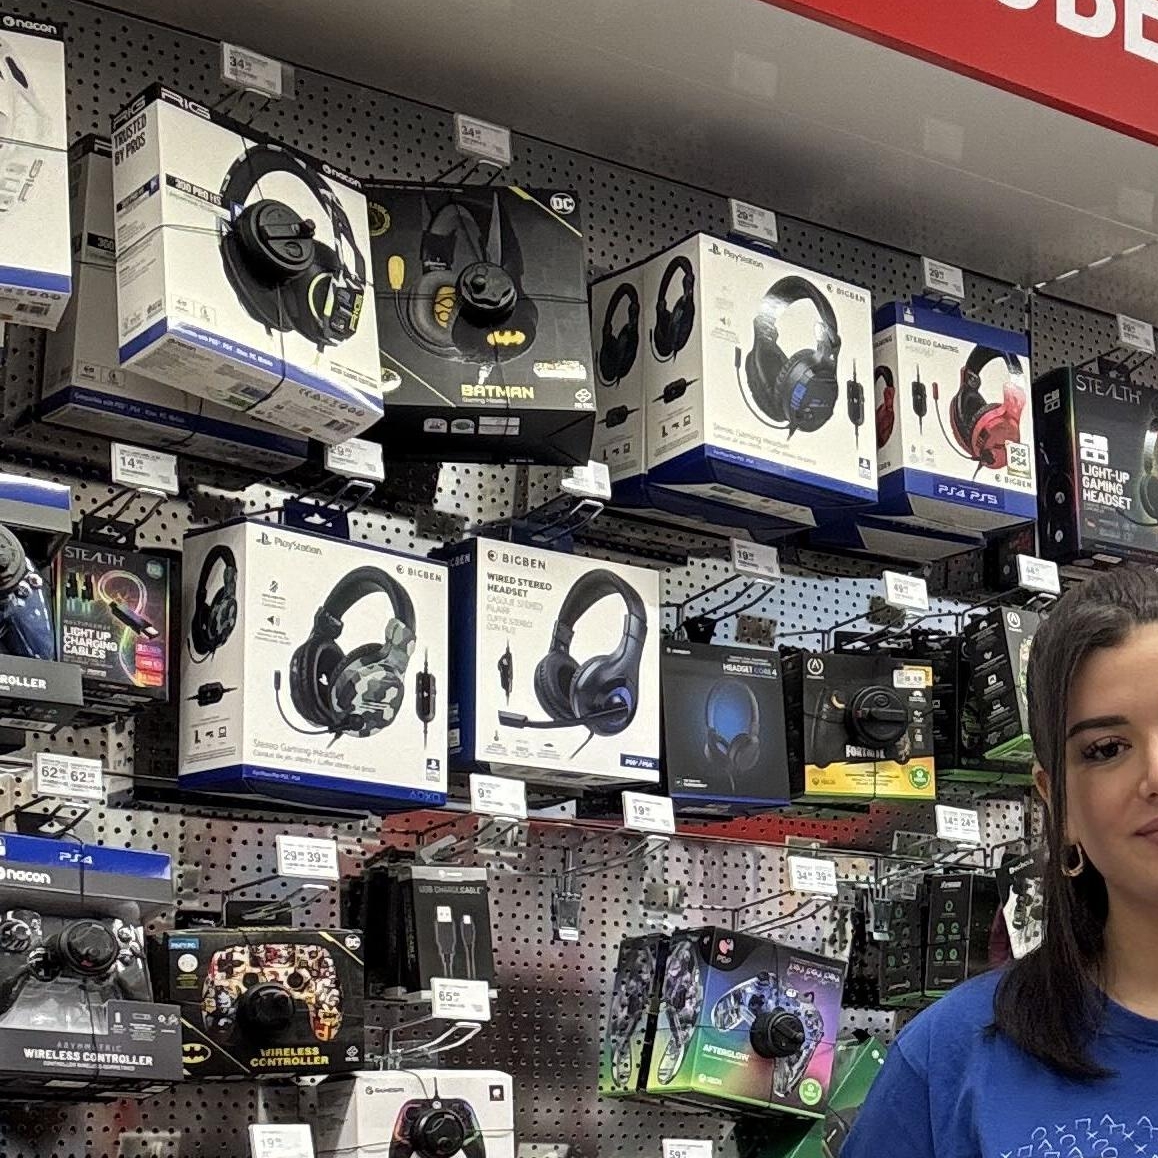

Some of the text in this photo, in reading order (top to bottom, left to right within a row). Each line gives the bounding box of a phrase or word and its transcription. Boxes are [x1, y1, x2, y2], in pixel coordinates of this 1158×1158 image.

[16, 19, 57, 35] nacon
[161, 87, 211, 120] RIG
[113, 113, 147, 149] TRUSTED
[461, 384, 534, 399] BATMAN
[1076, 374, 1141, 405] STEALTH
[1081, 462, 1130, 484] LIGHT-UP
[1082, 475, 1124, 495] GAMING
[938, 484, 999, 505] PS4 PS5
[1083, 487, 1132, 511] HEADSET
[274, 536, 323, 556] PlayStation
[63, 546, 125, 567] STEALTH
[502, 553, 546, 570] BIGBEN
[407, 567, 443, 583] BIGBEN
[487, 572, 552, 591] WIRED STEREO
[487, 584, 528, 598] HEADSET
[63, 625, 112, 641] LIGHT UP
[64, 634, 118, 652] CHARGING
[64, 644, 107, 660] CABLES
[59, 850, 93, 865] PS4
[7, 869, 51, 885] nacon
[56, 1041, 123, 1051] ASYMMTRIC
[261, 1046, 320, 1057] WIRELESS
[702, 1043, 750, 1062] AFTERGLOW
[24, 1048, 81, 1063] WIRELESS
[82, 1050, 153, 1067] CONTROLLER
[250, 1055, 329, 1068] CONTROLLER
